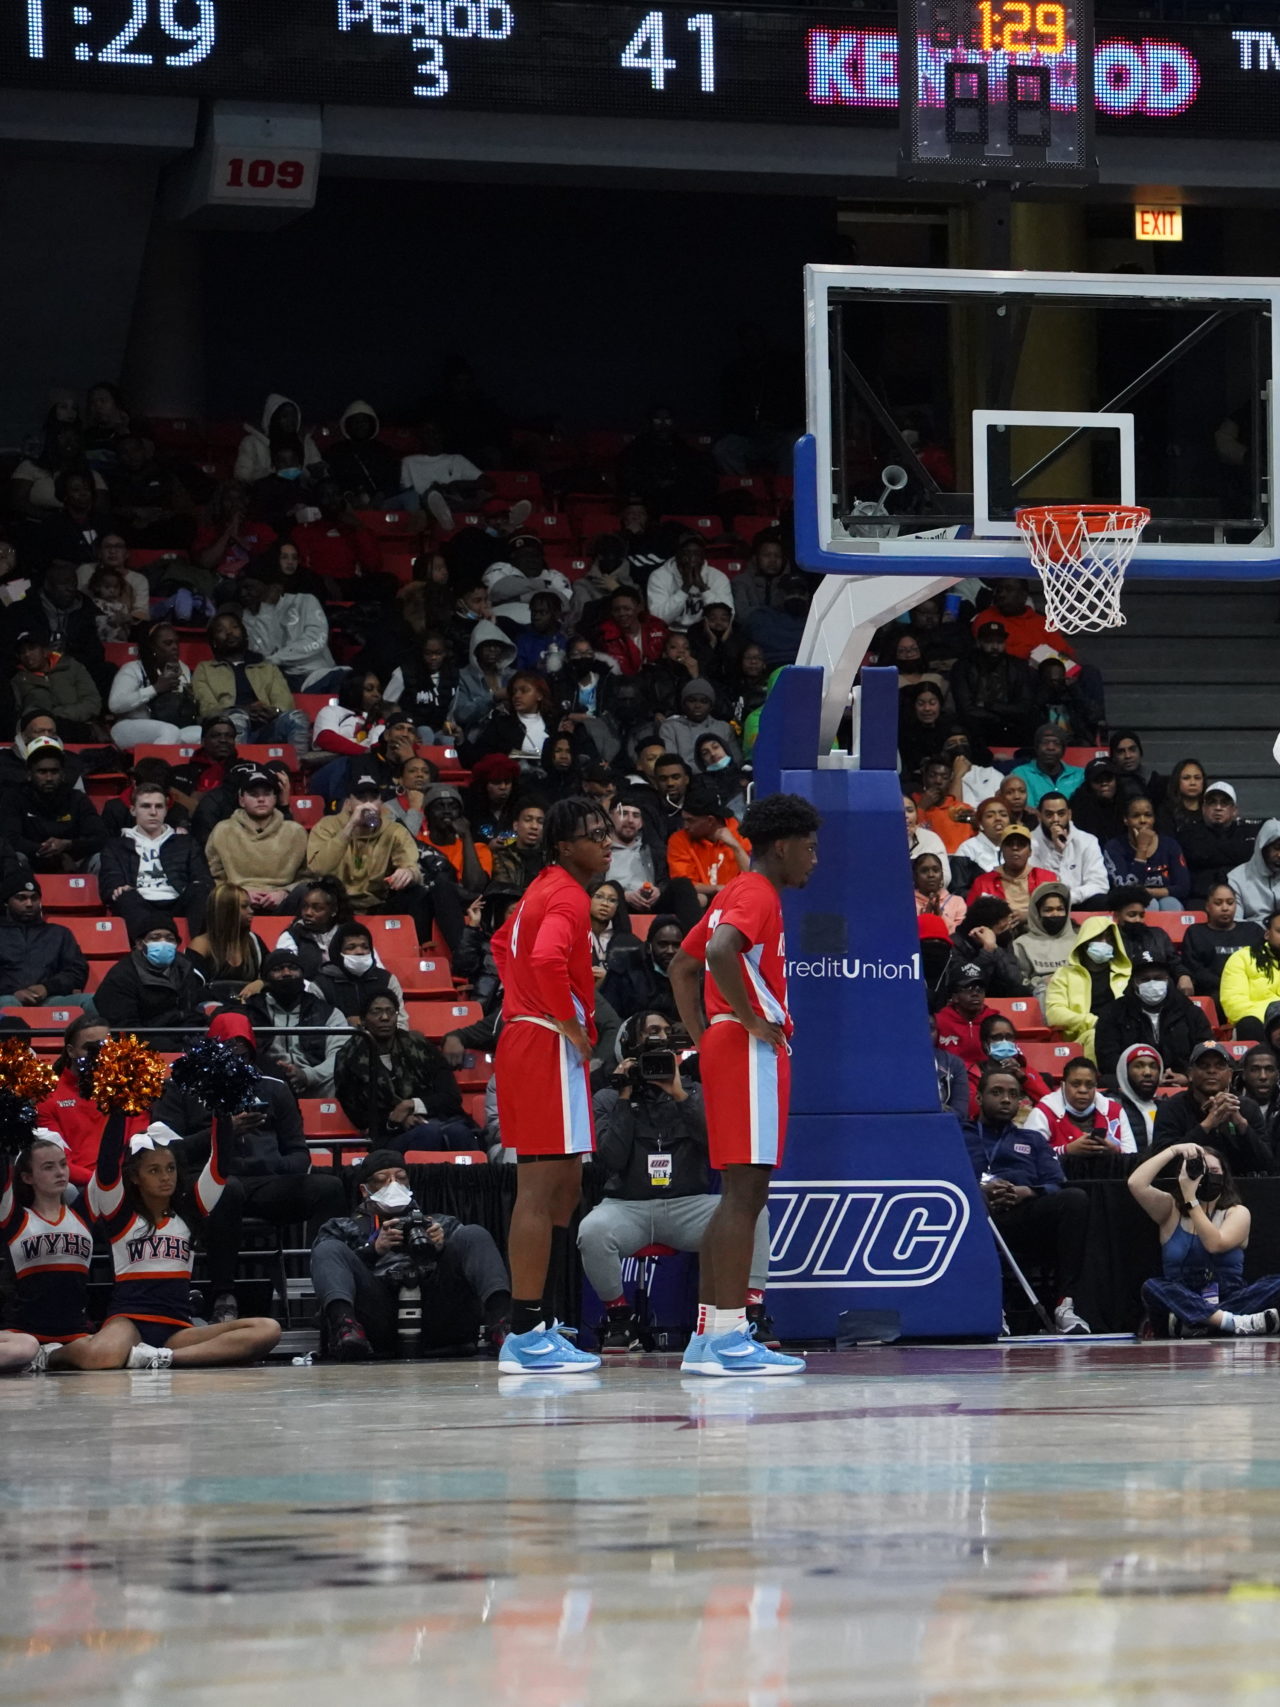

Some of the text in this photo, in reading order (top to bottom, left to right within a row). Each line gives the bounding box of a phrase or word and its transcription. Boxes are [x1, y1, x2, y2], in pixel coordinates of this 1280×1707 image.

[28, 0, 214, 66] 1:29
[337, 0, 514, 41] PERIOD
[978, 0, 1066, 53] 1:29
[412, 38, 449, 97] 3
[226, 158, 304, 189] 109
[1141, 210, 1176, 236] EXIT
[784, 953, 920, 980] reditUnion1
[22, 1233, 92, 1262] WYHS
[126, 1234, 191, 1264] WYHS
[768, 1192, 959, 1276] UIC
